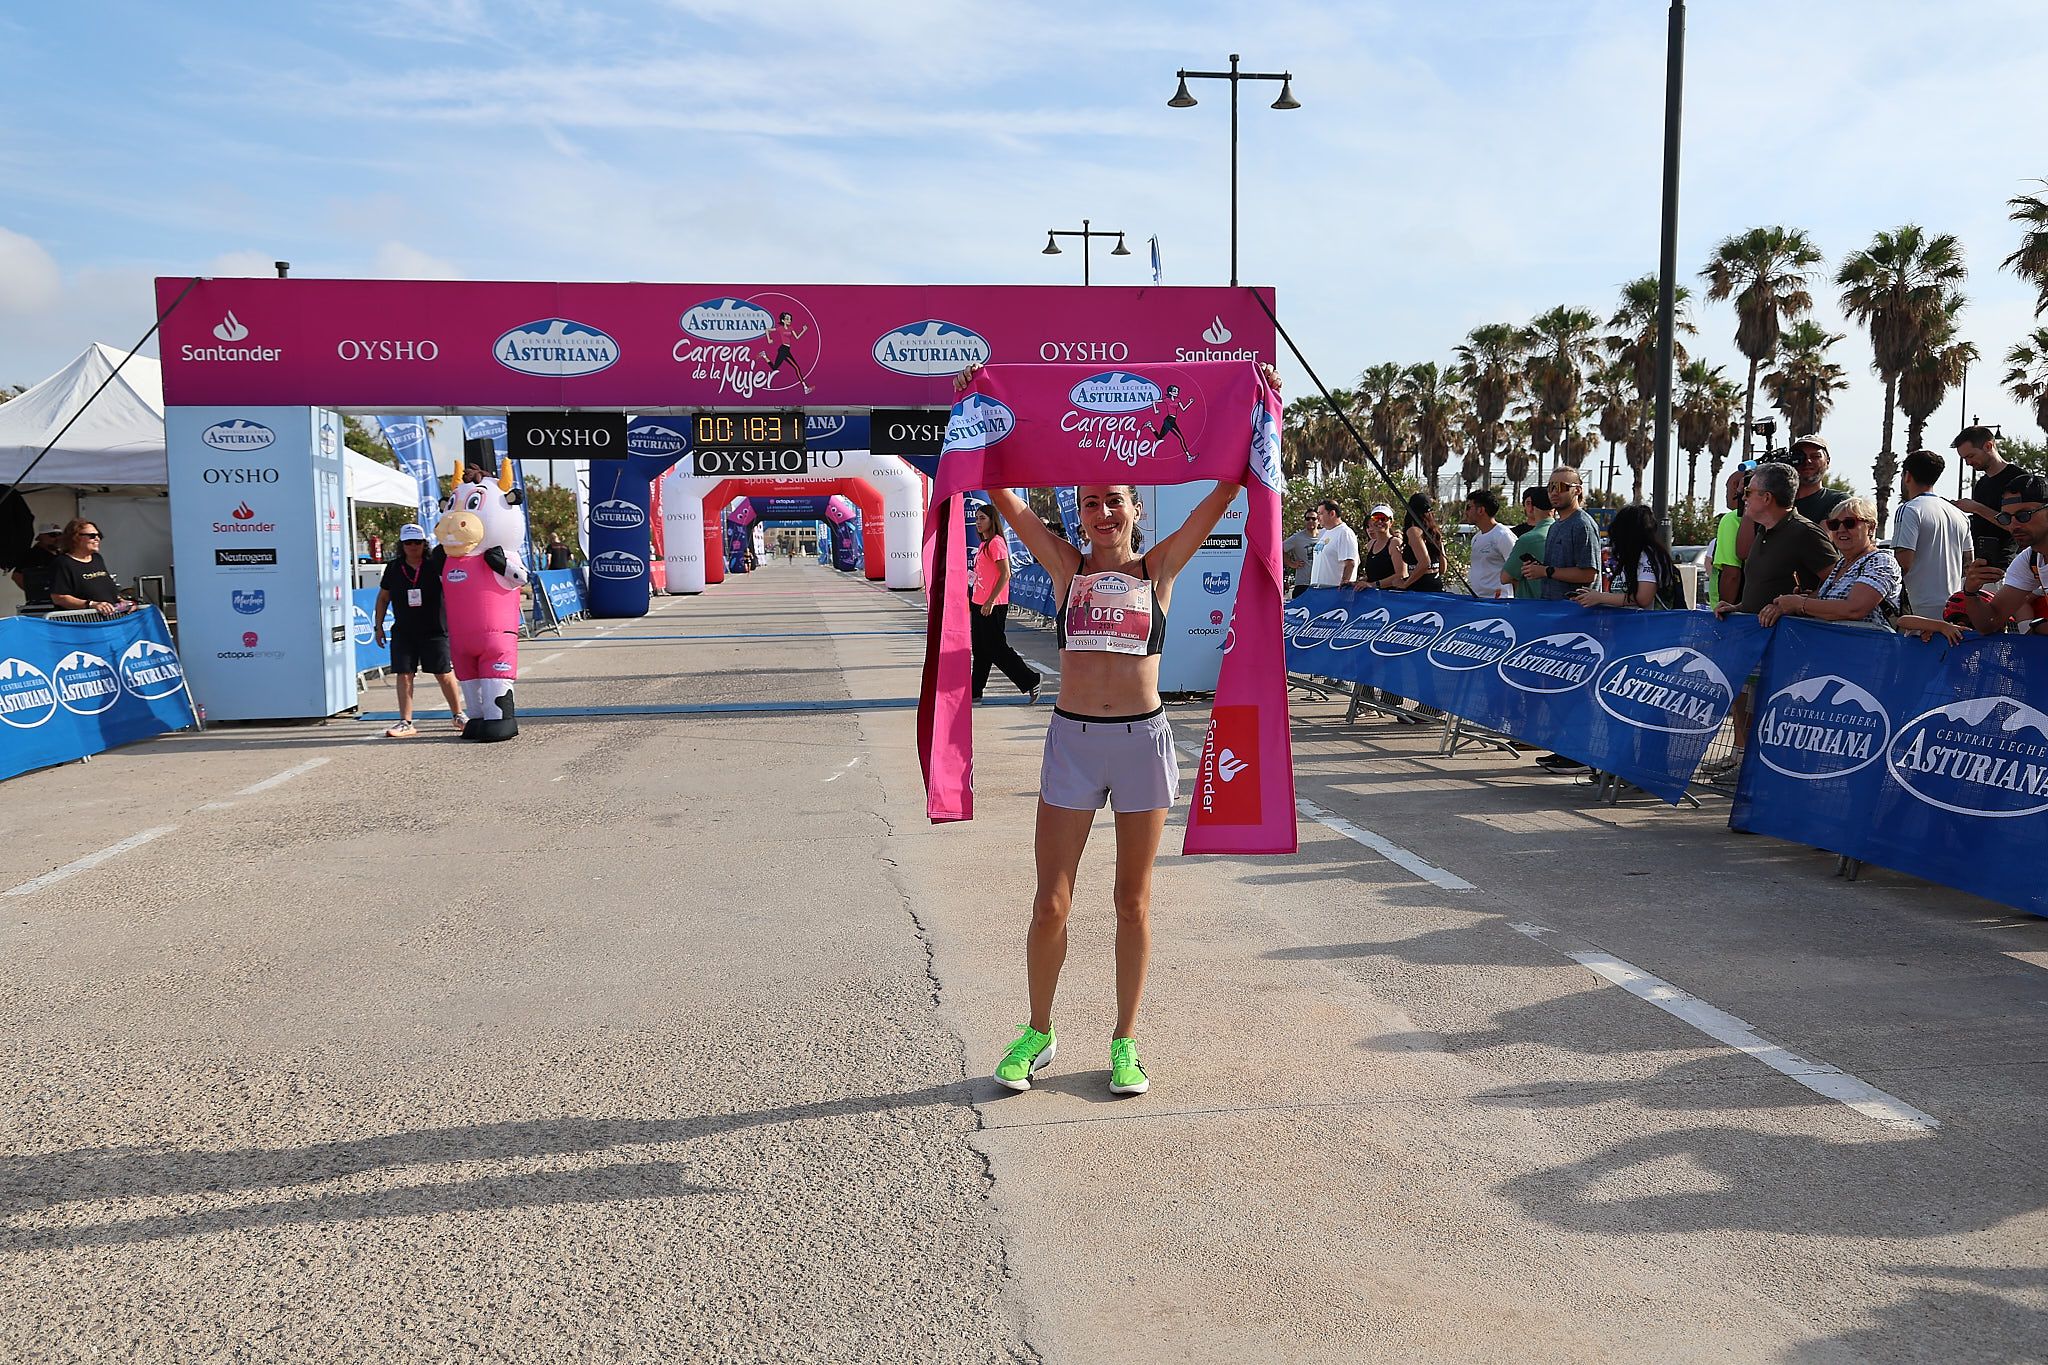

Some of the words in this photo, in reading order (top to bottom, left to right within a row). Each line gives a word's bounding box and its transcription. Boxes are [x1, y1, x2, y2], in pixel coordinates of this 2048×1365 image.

[687, 313, 768, 331] ASTURIANA
[337, 340, 439, 362] OYSHO
[503, 337, 610, 363] ASTURIANA
[521, 338, 562, 346] CENTRAL
[672, 338, 752, 363] Carrera
[882, 341, 982, 362] ASTURIANA
[1039, 341, 1129, 361] OYSHO
[181, 344, 282, 363] Santander
[1175, 347, 1259, 363] Santander
[692, 363, 707, 380] de
[709, 363, 721, 380] la
[718, 361, 780, 399] Mujer
[1076, 387, 1155, 403] ASTURIANA
[1059, 410, 1137, 433] Carrera
[208, 431, 271, 444] ASTURIANA
[526, 428, 611, 447] OYSHO
[888, 424, 946, 441] OYSH
[1078, 434, 1093, 449] de
[1095, 433, 1106, 449] la
[1102, 430, 1165, 467] Mujer
[698, 449, 803, 473] OYSHO
[203, 468, 279, 484] OYSHO
[594, 510, 640, 522] ASTURIANA
[667, 513, 696, 521] OYSHO
[890, 510, 918, 518] OYSHO
[213, 522, 276, 533] Santander
[1201, 538, 1240, 548] eutrogena
[219, 552, 273, 564] Neutrogena
[594, 560, 640, 573] ASTURIANA
[667, 555, 697, 563] OYSHO
[1094, 582, 1127, 592] ASTURIANA
[1091, 607, 1124, 622] 016
[1188, 627, 1220, 636] octopus
[1376, 624, 1430, 648] ASTURIANA
[217, 650, 254, 660] octopus
[1433, 633, 1501, 662] ASTURIANA
[1534, 647, 1564, 658] CENTRAL
[1564, 651, 1596, 663] LECHERA
[1503, 646, 1587, 683] ASTURIANA
[59, 677, 117, 701] ASTURIANA
[1635, 666, 1676, 683] CENTRAL
[1675, 677, 1721, 699] LECHERA
[1600, 664, 1715, 727] ASTURIANA
[1783, 706, 1826, 722] CENTRAL
[1828, 712, 1878, 728] LECHERA
[1761, 707, 1873, 760] ASTURIANA
[1936, 729, 1993, 748] CENTRAL
[1999, 739, 2047, 758] LECHE
[1203, 719, 1217, 814] Santander
